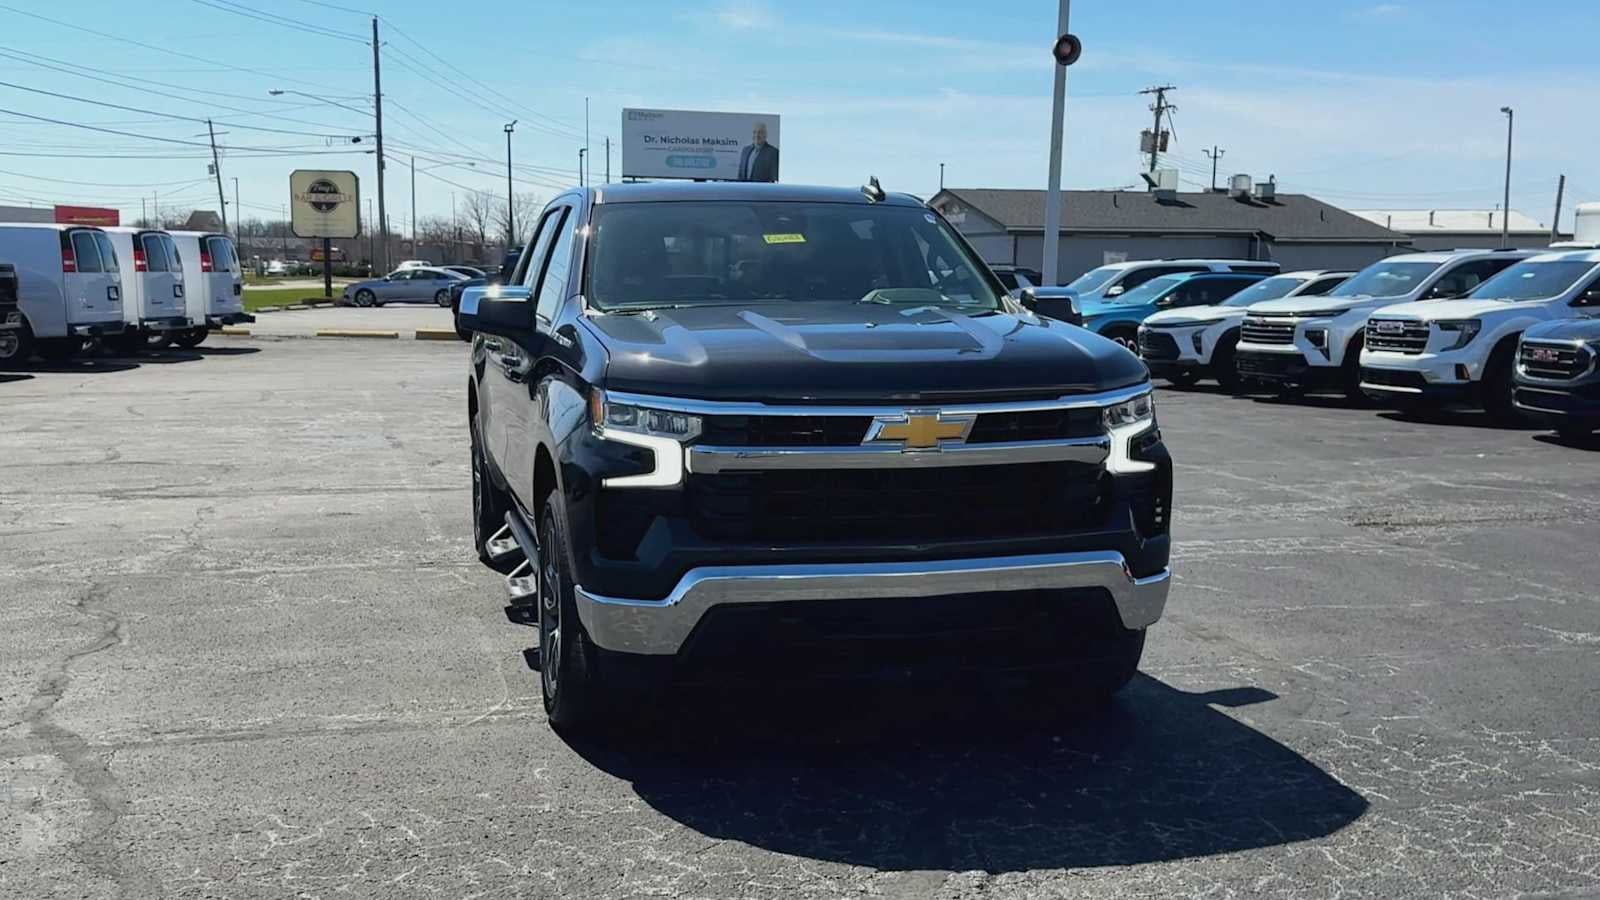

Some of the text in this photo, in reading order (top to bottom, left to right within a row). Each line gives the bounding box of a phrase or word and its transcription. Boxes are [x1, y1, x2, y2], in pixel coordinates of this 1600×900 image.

[644, 135, 738, 147] Dr. Nicholas Maksim
